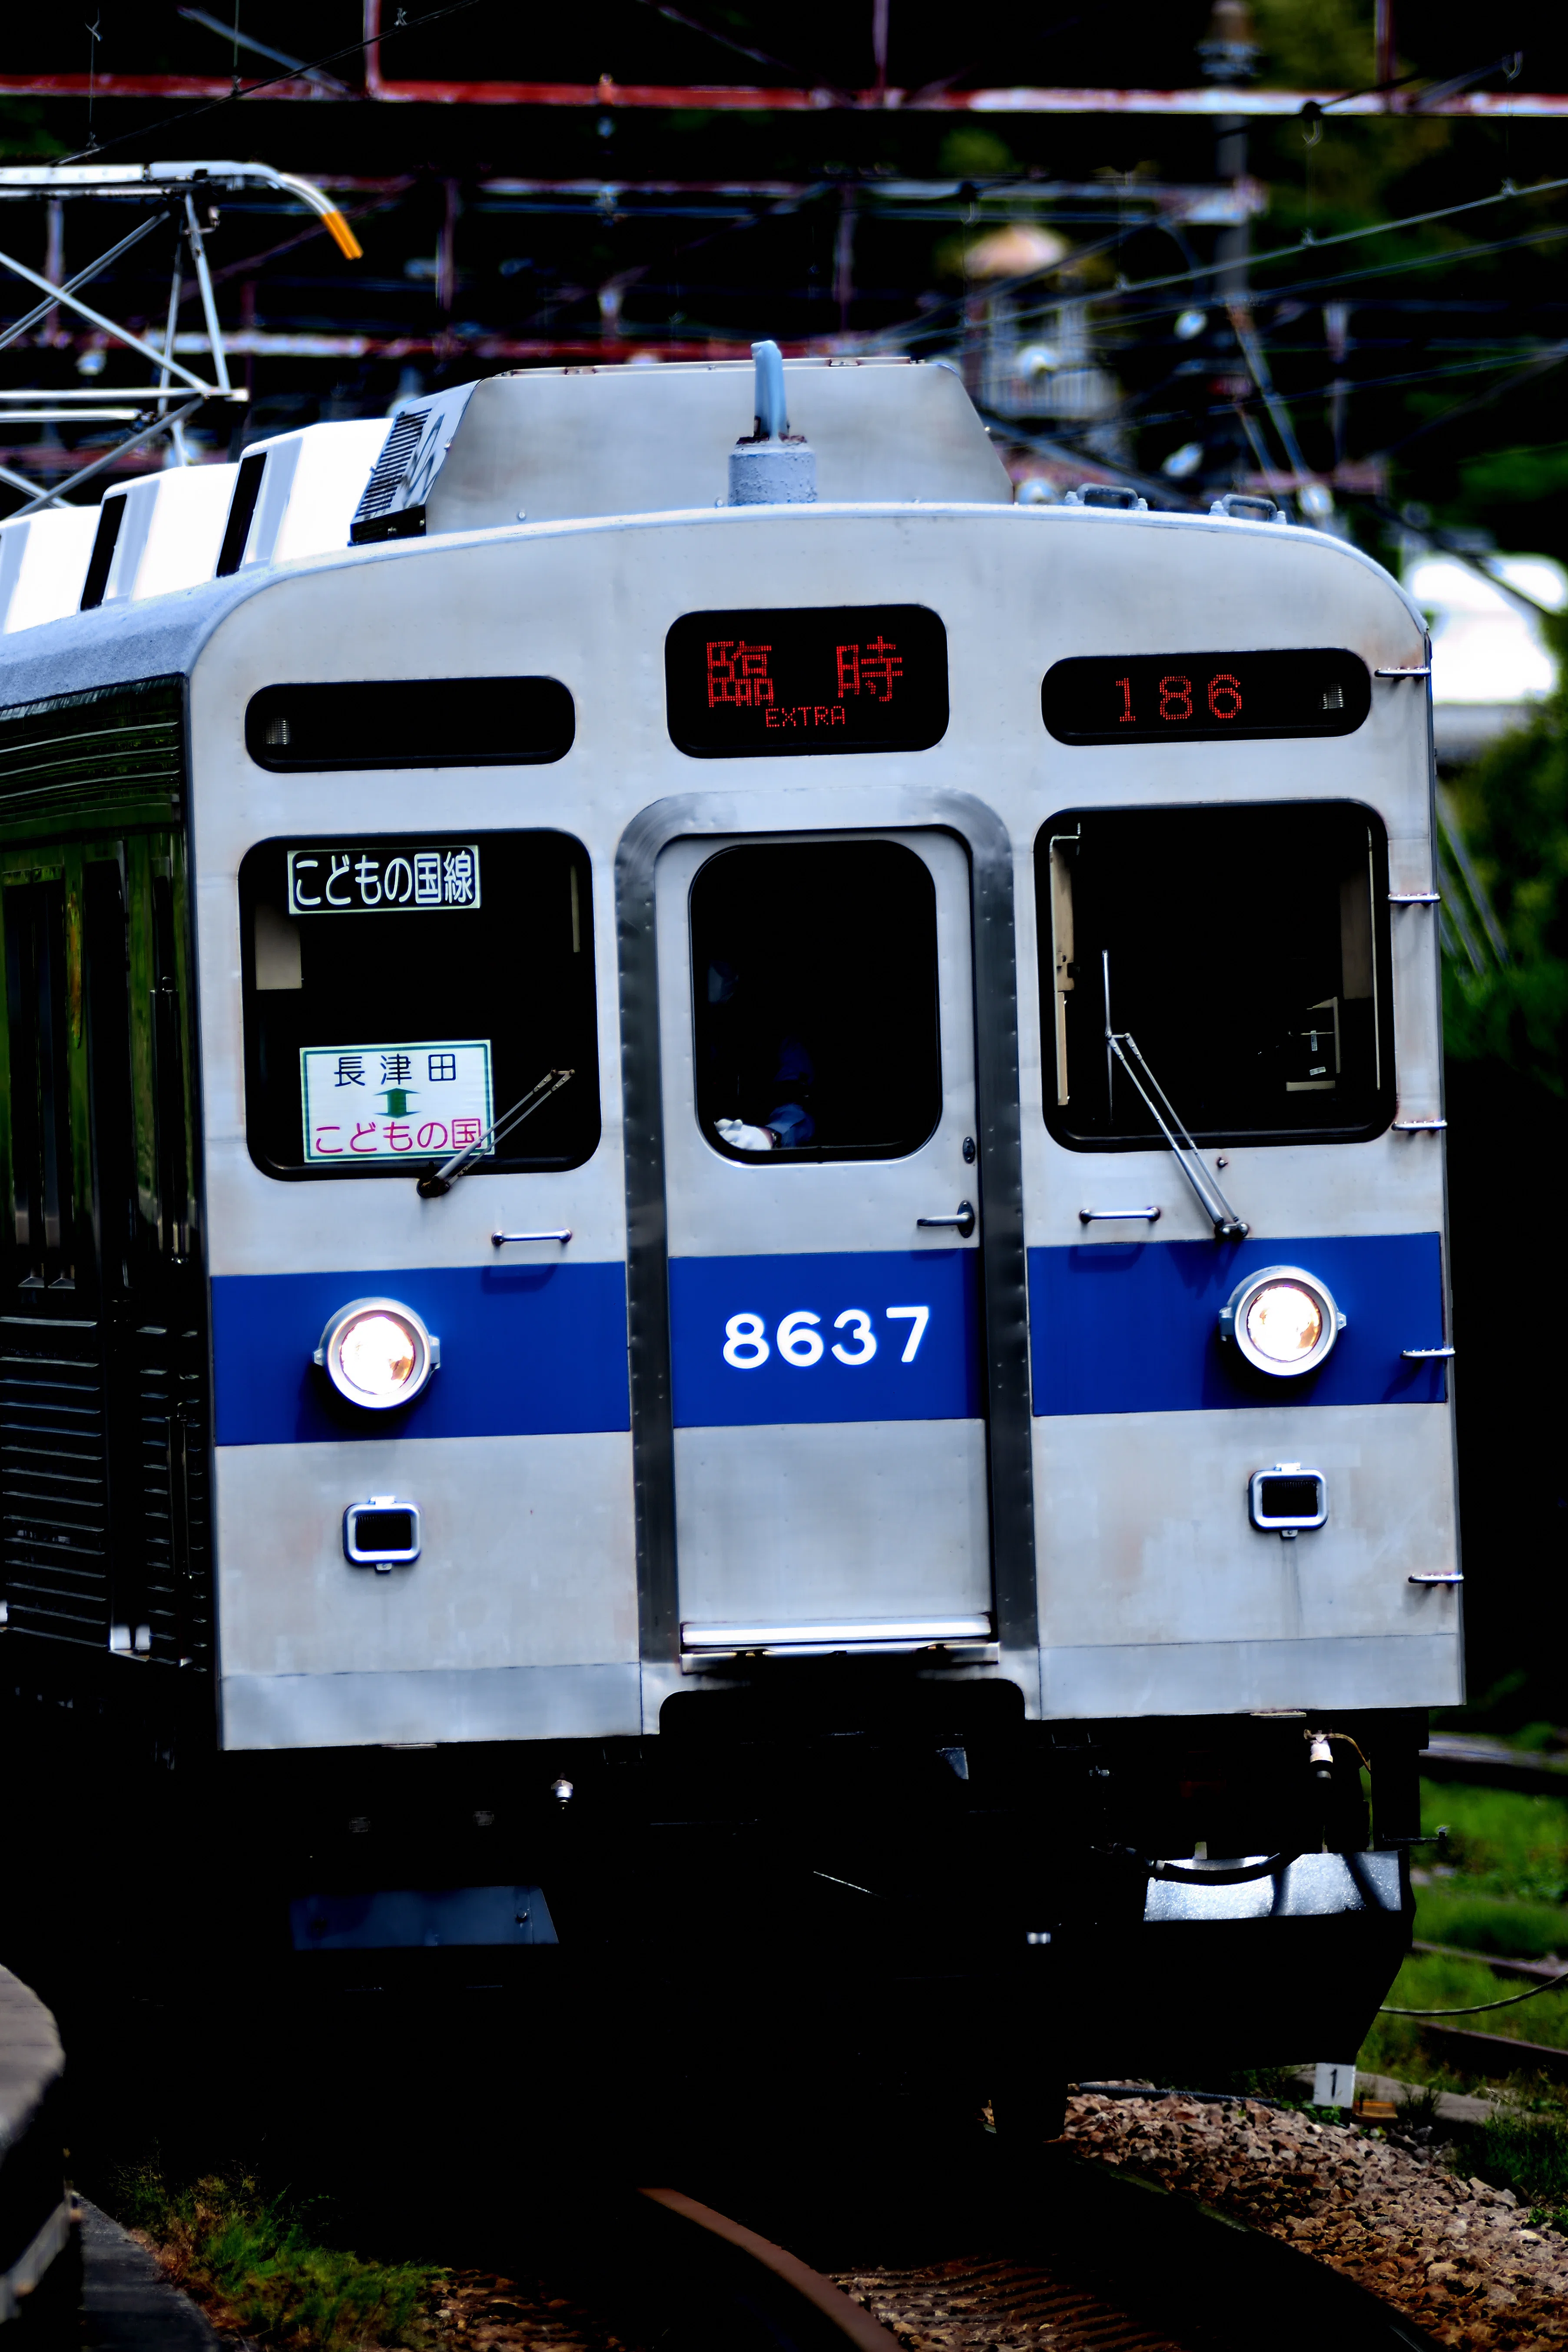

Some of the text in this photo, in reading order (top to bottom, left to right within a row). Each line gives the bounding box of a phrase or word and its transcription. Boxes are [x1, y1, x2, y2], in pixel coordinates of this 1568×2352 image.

[1115, 674, 1243, 722] 186
[765, 706, 845, 728] EXTRA
[296, 850, 473, 905] こどもの国線
[334, 1053, 456, 1087] 長津田
[315, 1118, 481, 1154] こどもの国
[723, 1306, 929, 1369] 8637
[1330, 2068, 1338, 2101] 1
